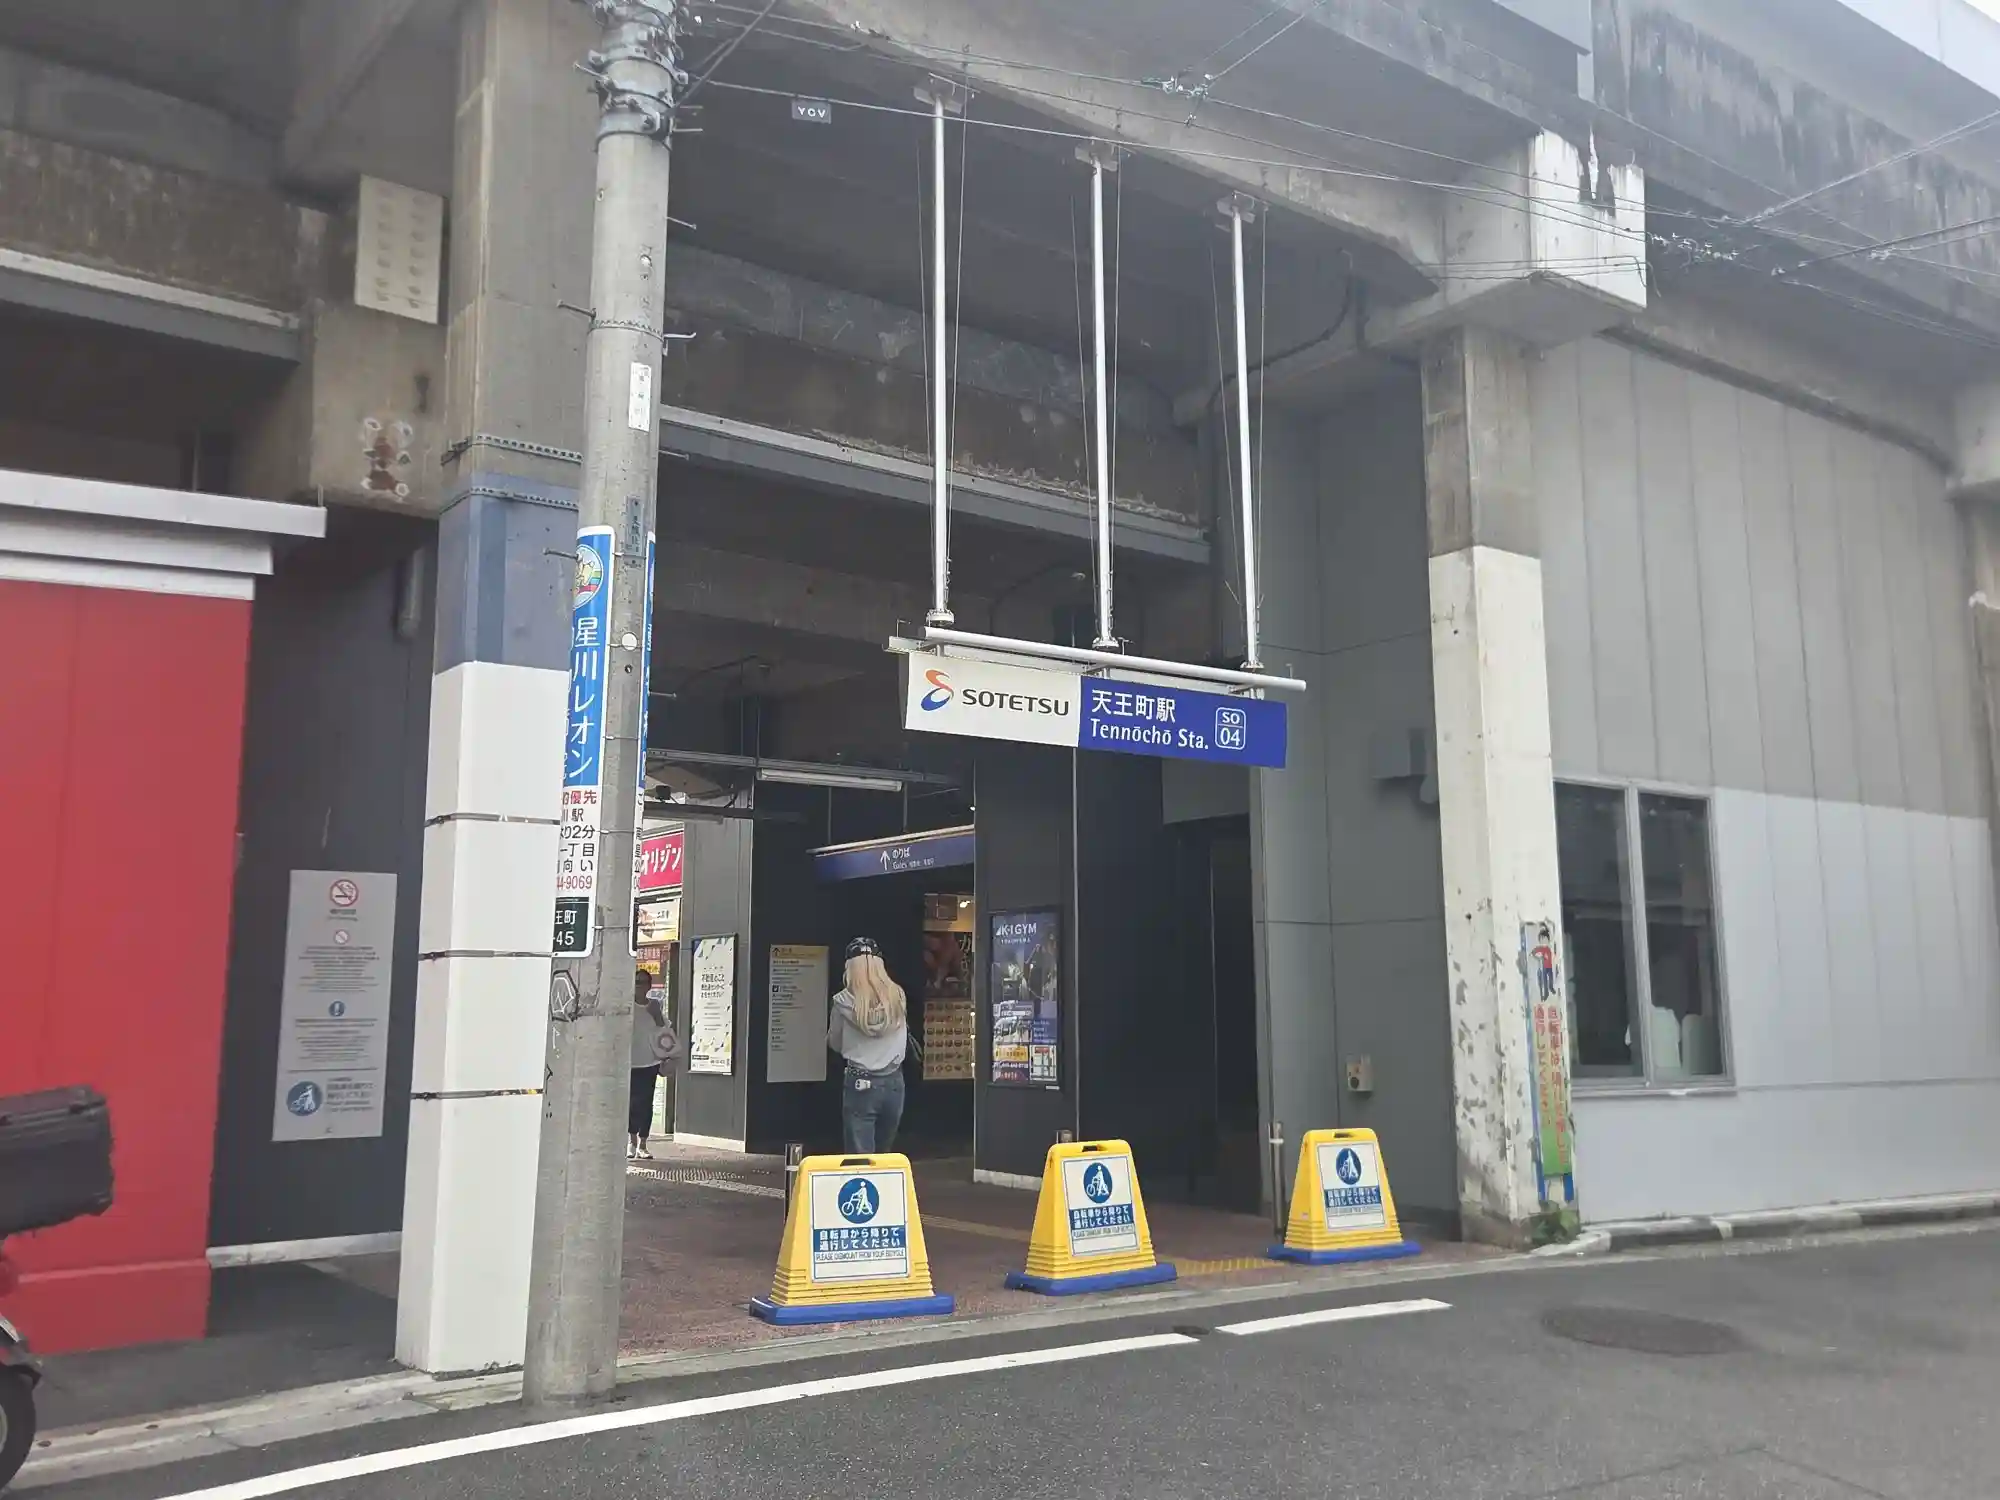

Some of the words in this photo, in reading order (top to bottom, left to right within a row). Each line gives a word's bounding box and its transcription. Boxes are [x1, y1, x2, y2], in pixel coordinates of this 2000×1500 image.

[962, 688, 1069, 716] SOTETSU
[1091, 689, 1176, 723] 天王町駅
[1222, 711, 1240, 725] SO
[1177, 728, 1209, 750] Sta.
[1220, 727, 1240, 746] 04
[1014, 922, 1037, 935] GYM
[819, 1227, 900, 1241] 自転車から降りて
[819, 1238, 900, 1251] 通行してください
